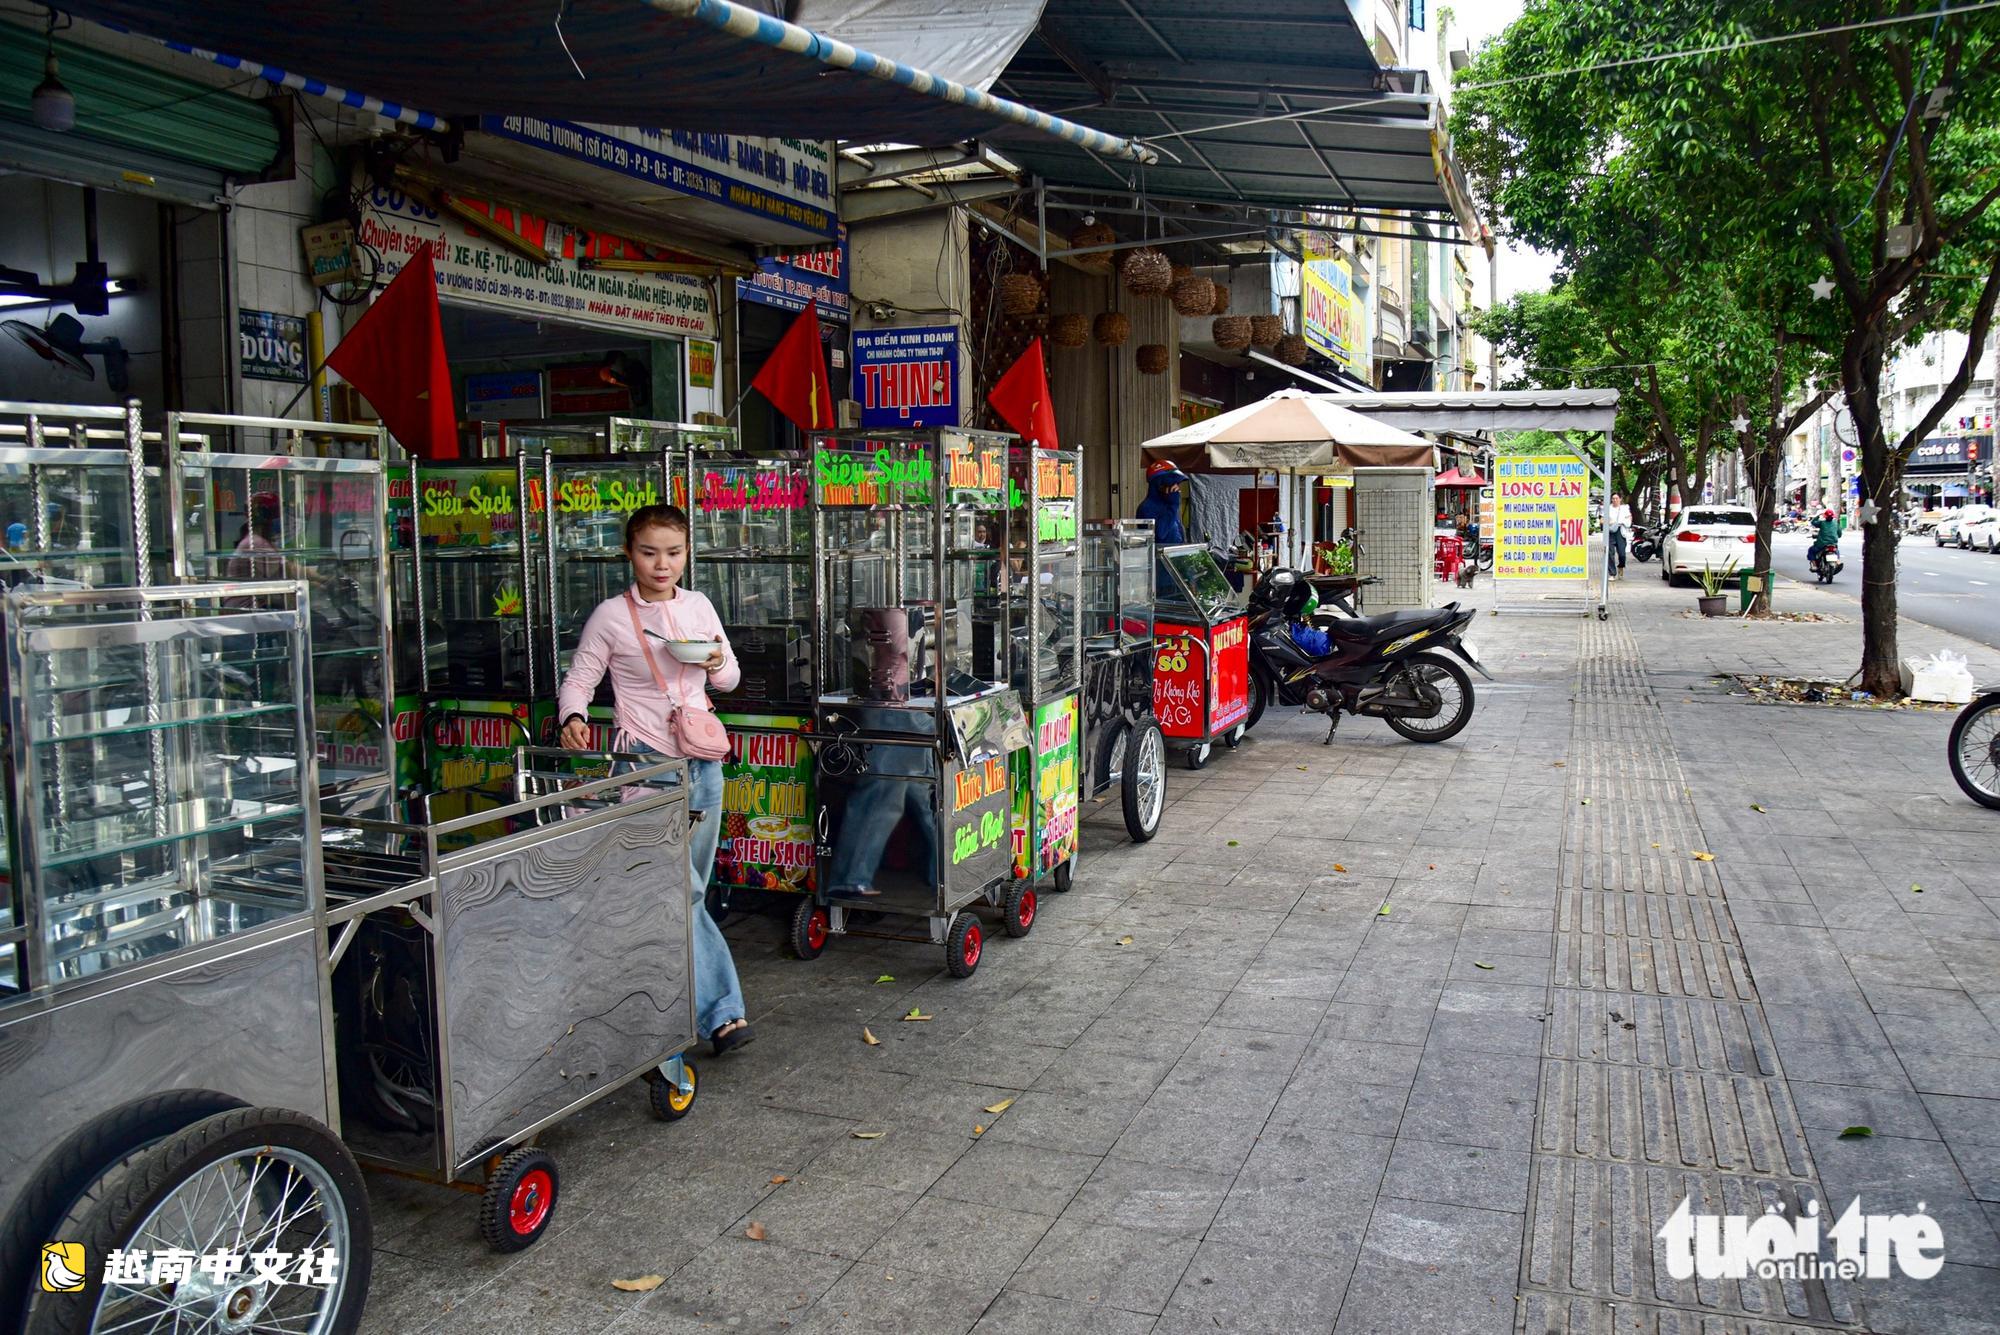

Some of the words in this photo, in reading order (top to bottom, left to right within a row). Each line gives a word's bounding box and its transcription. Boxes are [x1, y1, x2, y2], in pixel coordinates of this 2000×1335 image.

[615, 147, 629, 168] 29)
[654, 160, 667, 179] Q.5
[363, 218, 402, 254] Chuyên
[455, 246, 470, 266] XE
[656, 311, 674, 326] THEO
[1306, 282, 1327, 330] LONG
[857, 337, 872, 348] ĐỊA
[874, 332, 898, 346] ĐIỂM
[900, 335, 921, 345] KINH
[923, 332, 954, 343] DOANH
[860, 361, 951, 418] THỊNH
[949, 442, 979, 489] Nước
[1917, 445, 1943, 457] cafe
[1945, 443, 1960, 455] 68
[815, 450, 866, 487] Siêu
[874, 448, 933, 490] Sạch
[1538, 464, 1557, 475] NAM
[1560, 463, 1584, 475] VANG
[425, 487, 465, 517] Siêu
[469, 486, 514, 519] Sạch
[560, 480, 600, 513] Siêu
[1501, 482, 1544, 497] LONG
[1549, 478, 1582, 497] LÂN
[1514, 520, 1525, 529] KHO
[1560, 519, 1584, 545] 50K
[1158, 651, 1189, 672] SỐ
[1163, 679, 1185, 705] Không
[1186, 680, 1200, 706] Khó
[1160, 704, 1173, 728] Là
[1175, 706, 1191, 725] Có
[770, 776, 806, 817] MÍA
[955, 767, 982, 812] Nước
[984, 757, 1006, 797] Mía
[733, 836, 770, 864] SIÊU
[773, 841, 816, 871] SẠCH
